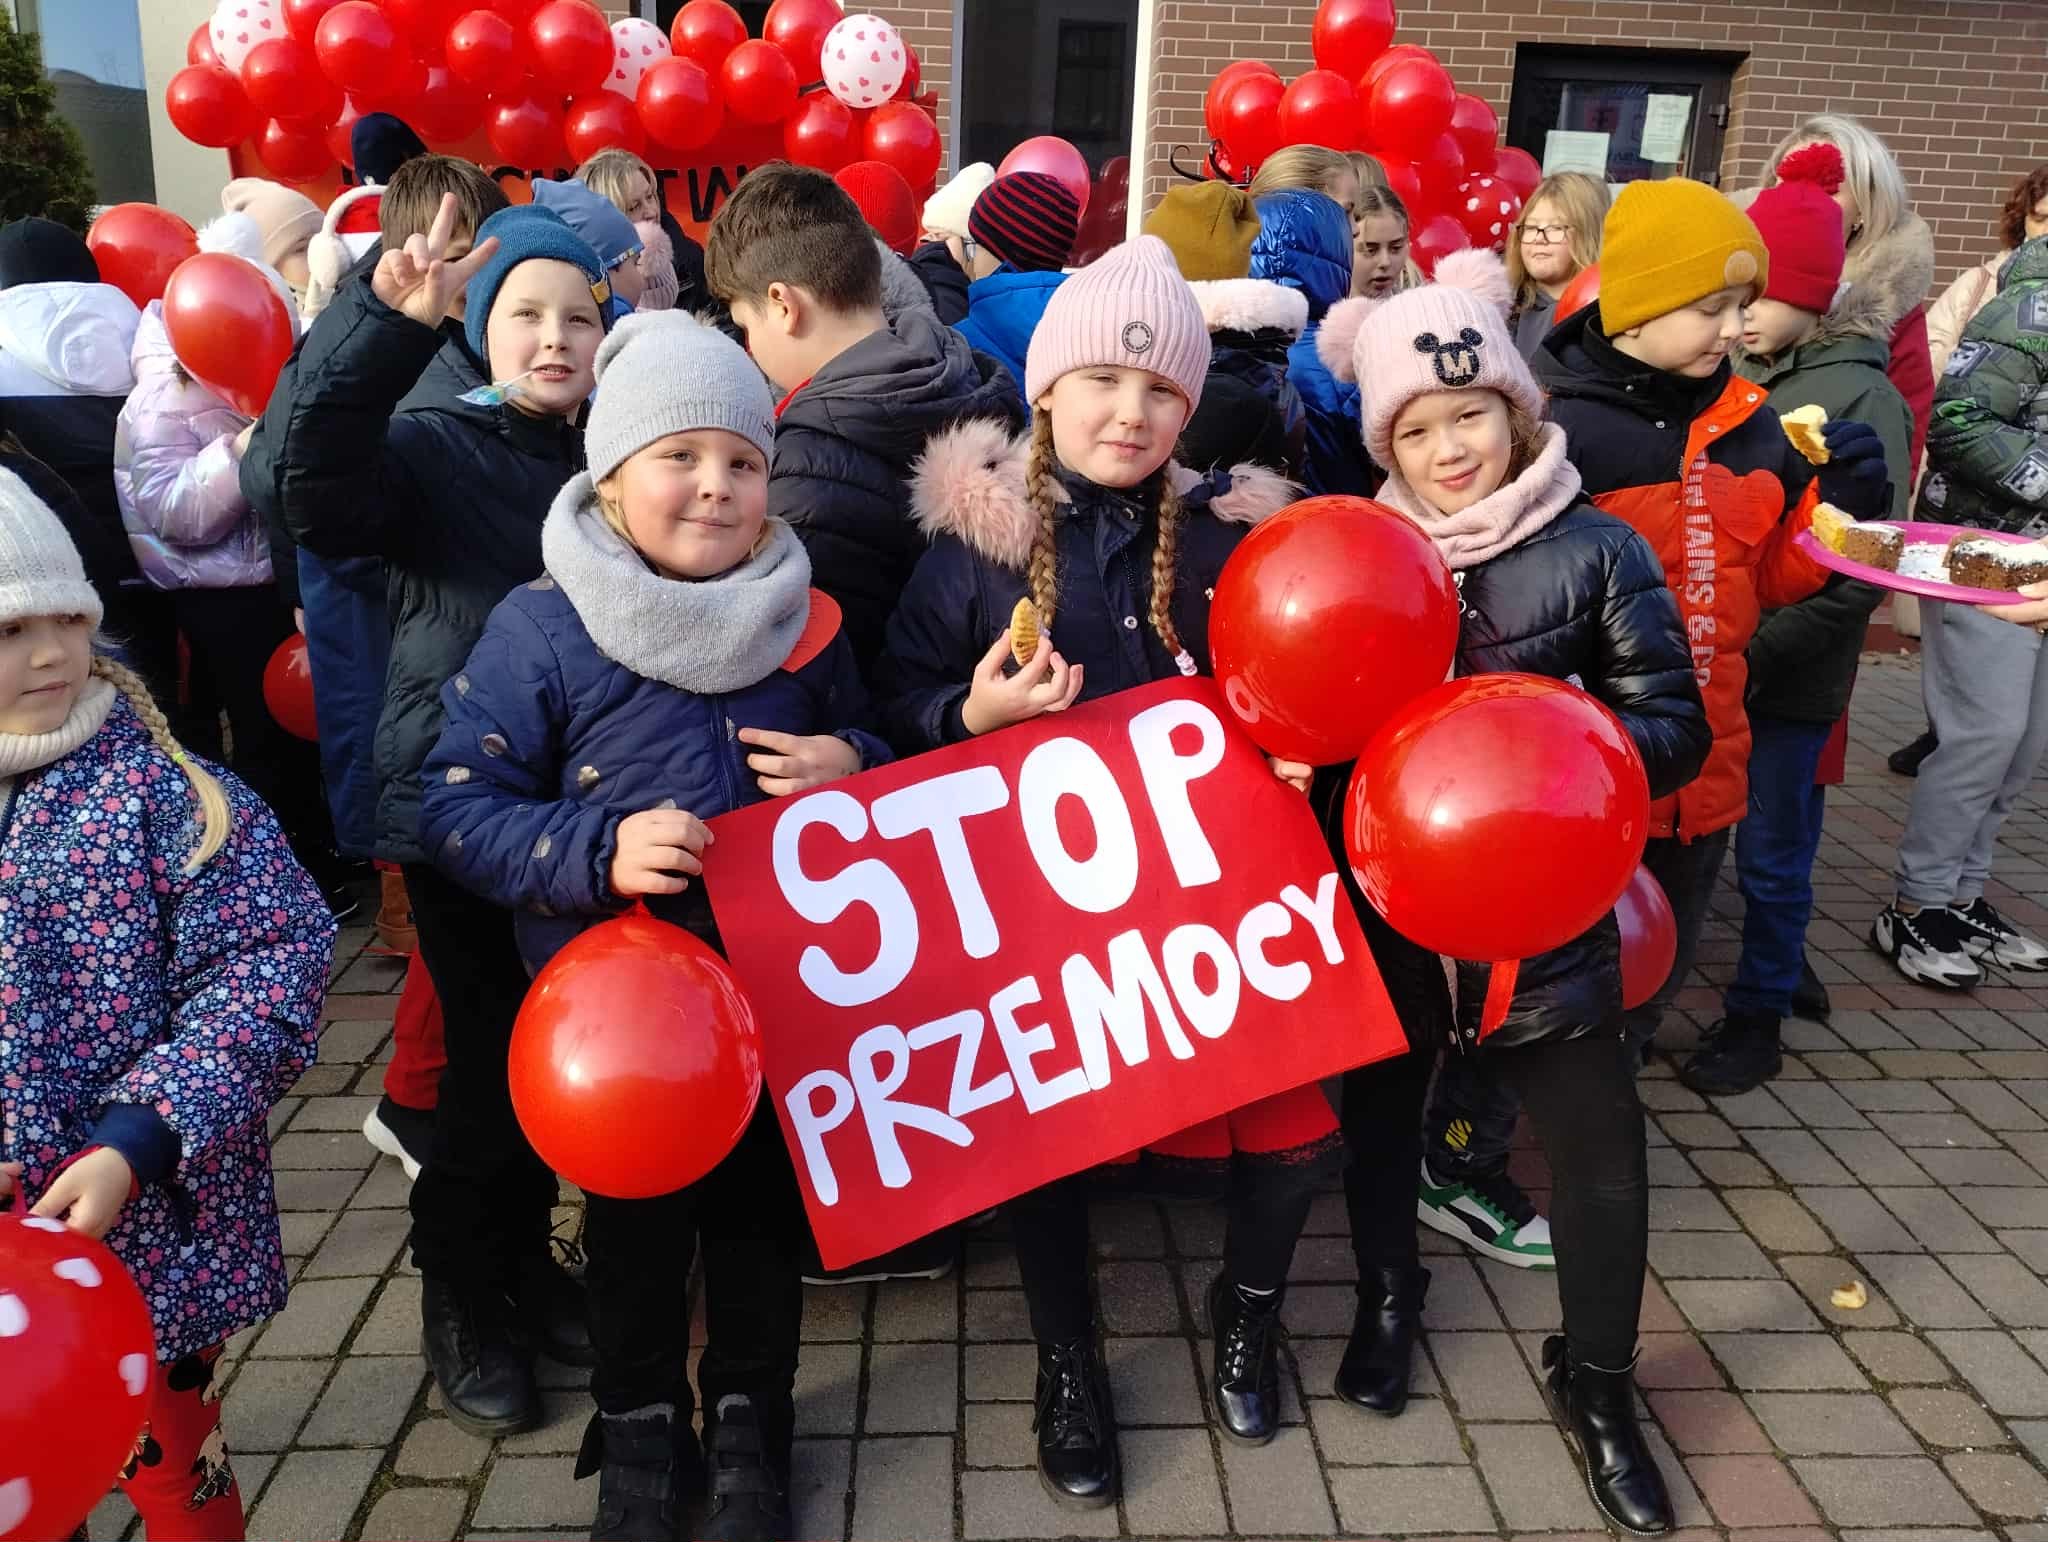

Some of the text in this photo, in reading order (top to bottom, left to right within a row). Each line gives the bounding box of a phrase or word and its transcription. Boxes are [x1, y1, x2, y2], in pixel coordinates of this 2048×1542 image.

[1440, 350, 1473, 379] M
[772, 699, 1226, 1007] STOP
[785, 872, 1345, 1206] PRZEMOCY
